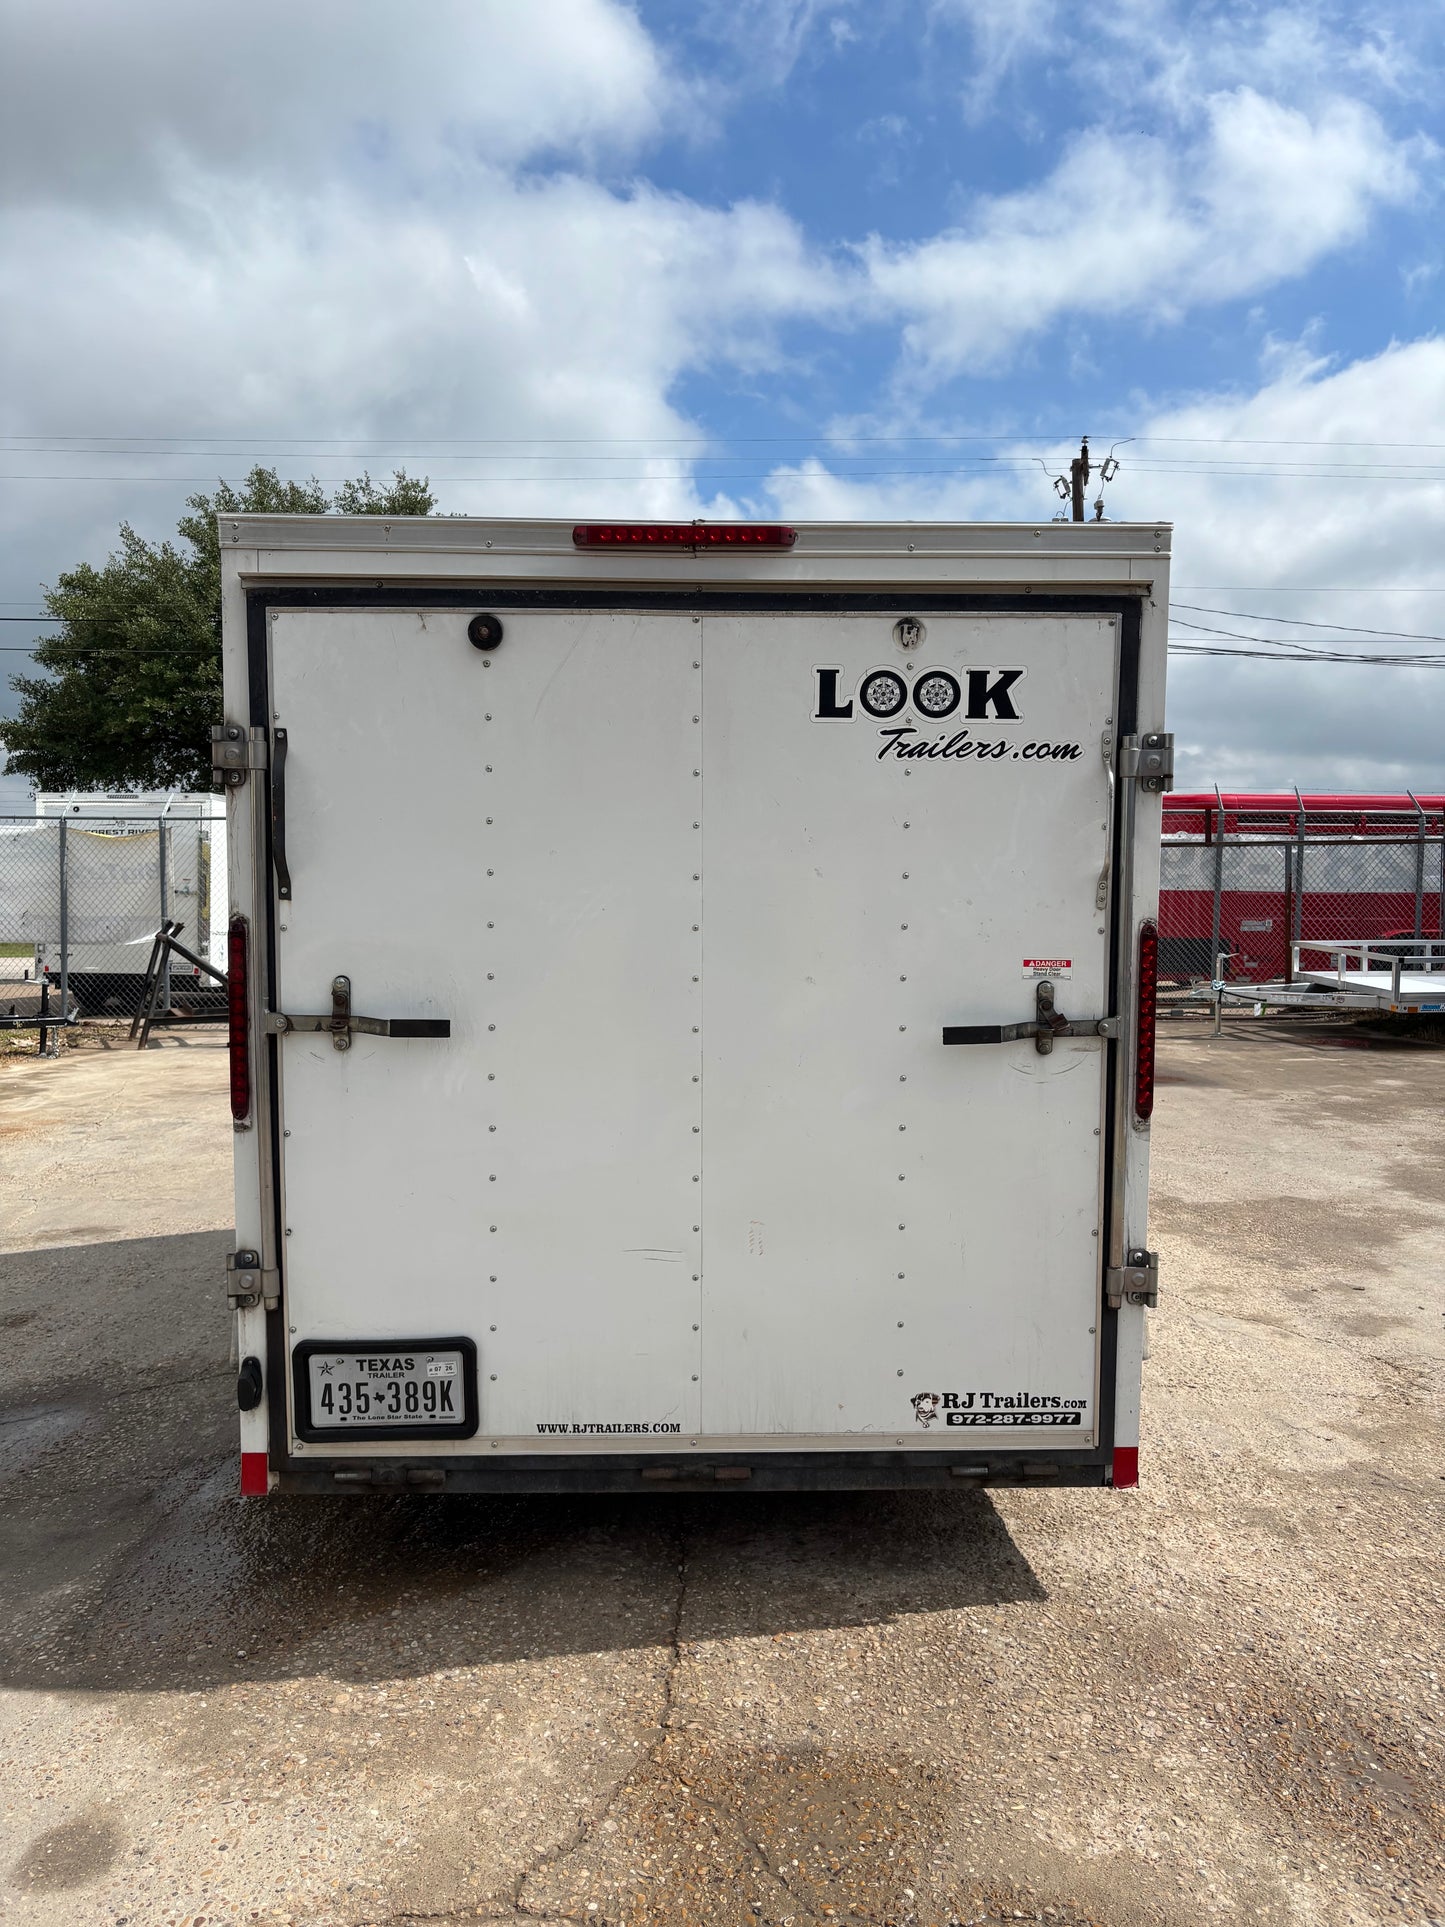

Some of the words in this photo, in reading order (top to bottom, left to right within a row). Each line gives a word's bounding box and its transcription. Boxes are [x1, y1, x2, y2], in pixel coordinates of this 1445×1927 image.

[815, 668, 1024, 719] LOOK
[879, 727, 1083, 760] Trailers.com
[356, 1358, 415, 1372] TEXAS
[941, 1393, 976, 1409] RJ
[951, 1413, 1076, 1424] 972-287-9977
[536, 1423, 681, 1434] WWW.RJTRAILERS.COM
